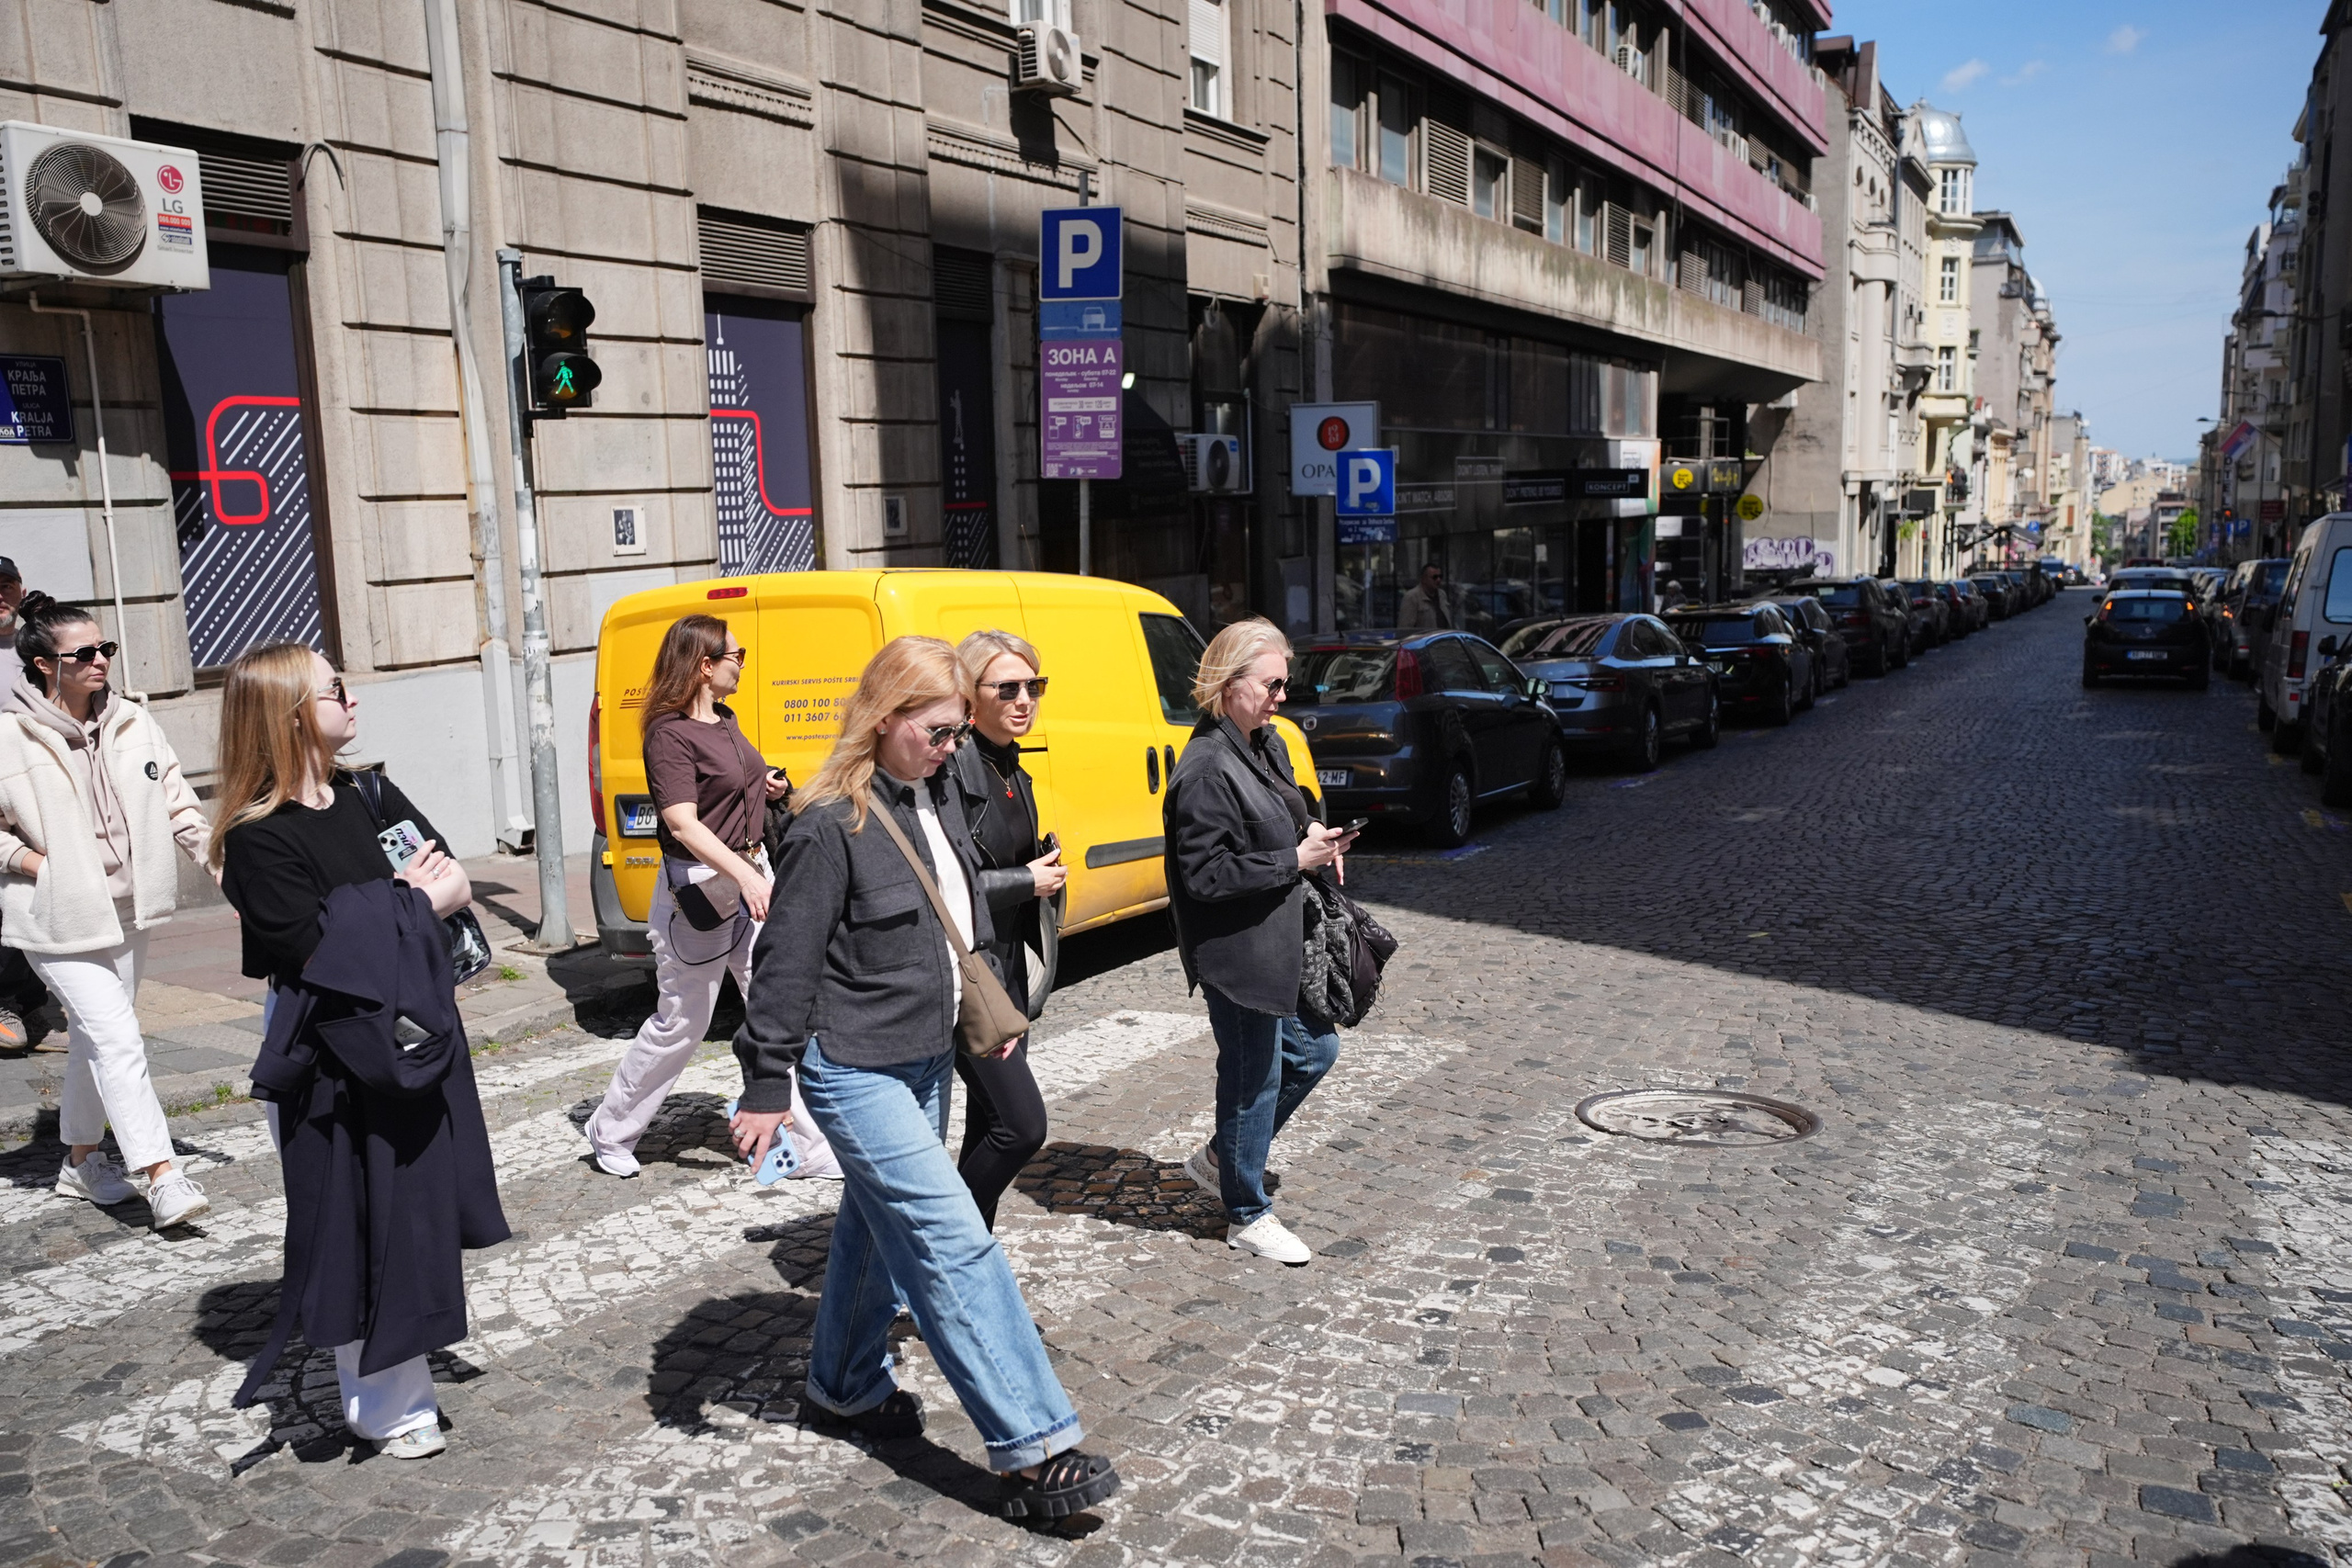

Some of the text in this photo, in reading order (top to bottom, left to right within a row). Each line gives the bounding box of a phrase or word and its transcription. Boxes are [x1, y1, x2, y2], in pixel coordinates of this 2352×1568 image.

[162, 198, 184, 214] LG
[1058, 220, 1102, 288] P
[1048, 347, 1098, 365] ЗОНА
[7, 369, 47, 382] КРАЉА
[11, 384, 47, 396] ПЕТРА
[11, 411, 54, 423] KRALJA
[17, 424, 52, 437] PETRA
[1301, 463, 1336, 479] OPA
[1349, 458, 1382, 508] P
[784, 697, 847, 709] 0800 100 80
[784, 712, 847, 723] 011 3607 60
[786, 733, 840, 741] www.postexpre
[637, 807, 654, 825] BG
[626, 856, 660, 865] DOBL
